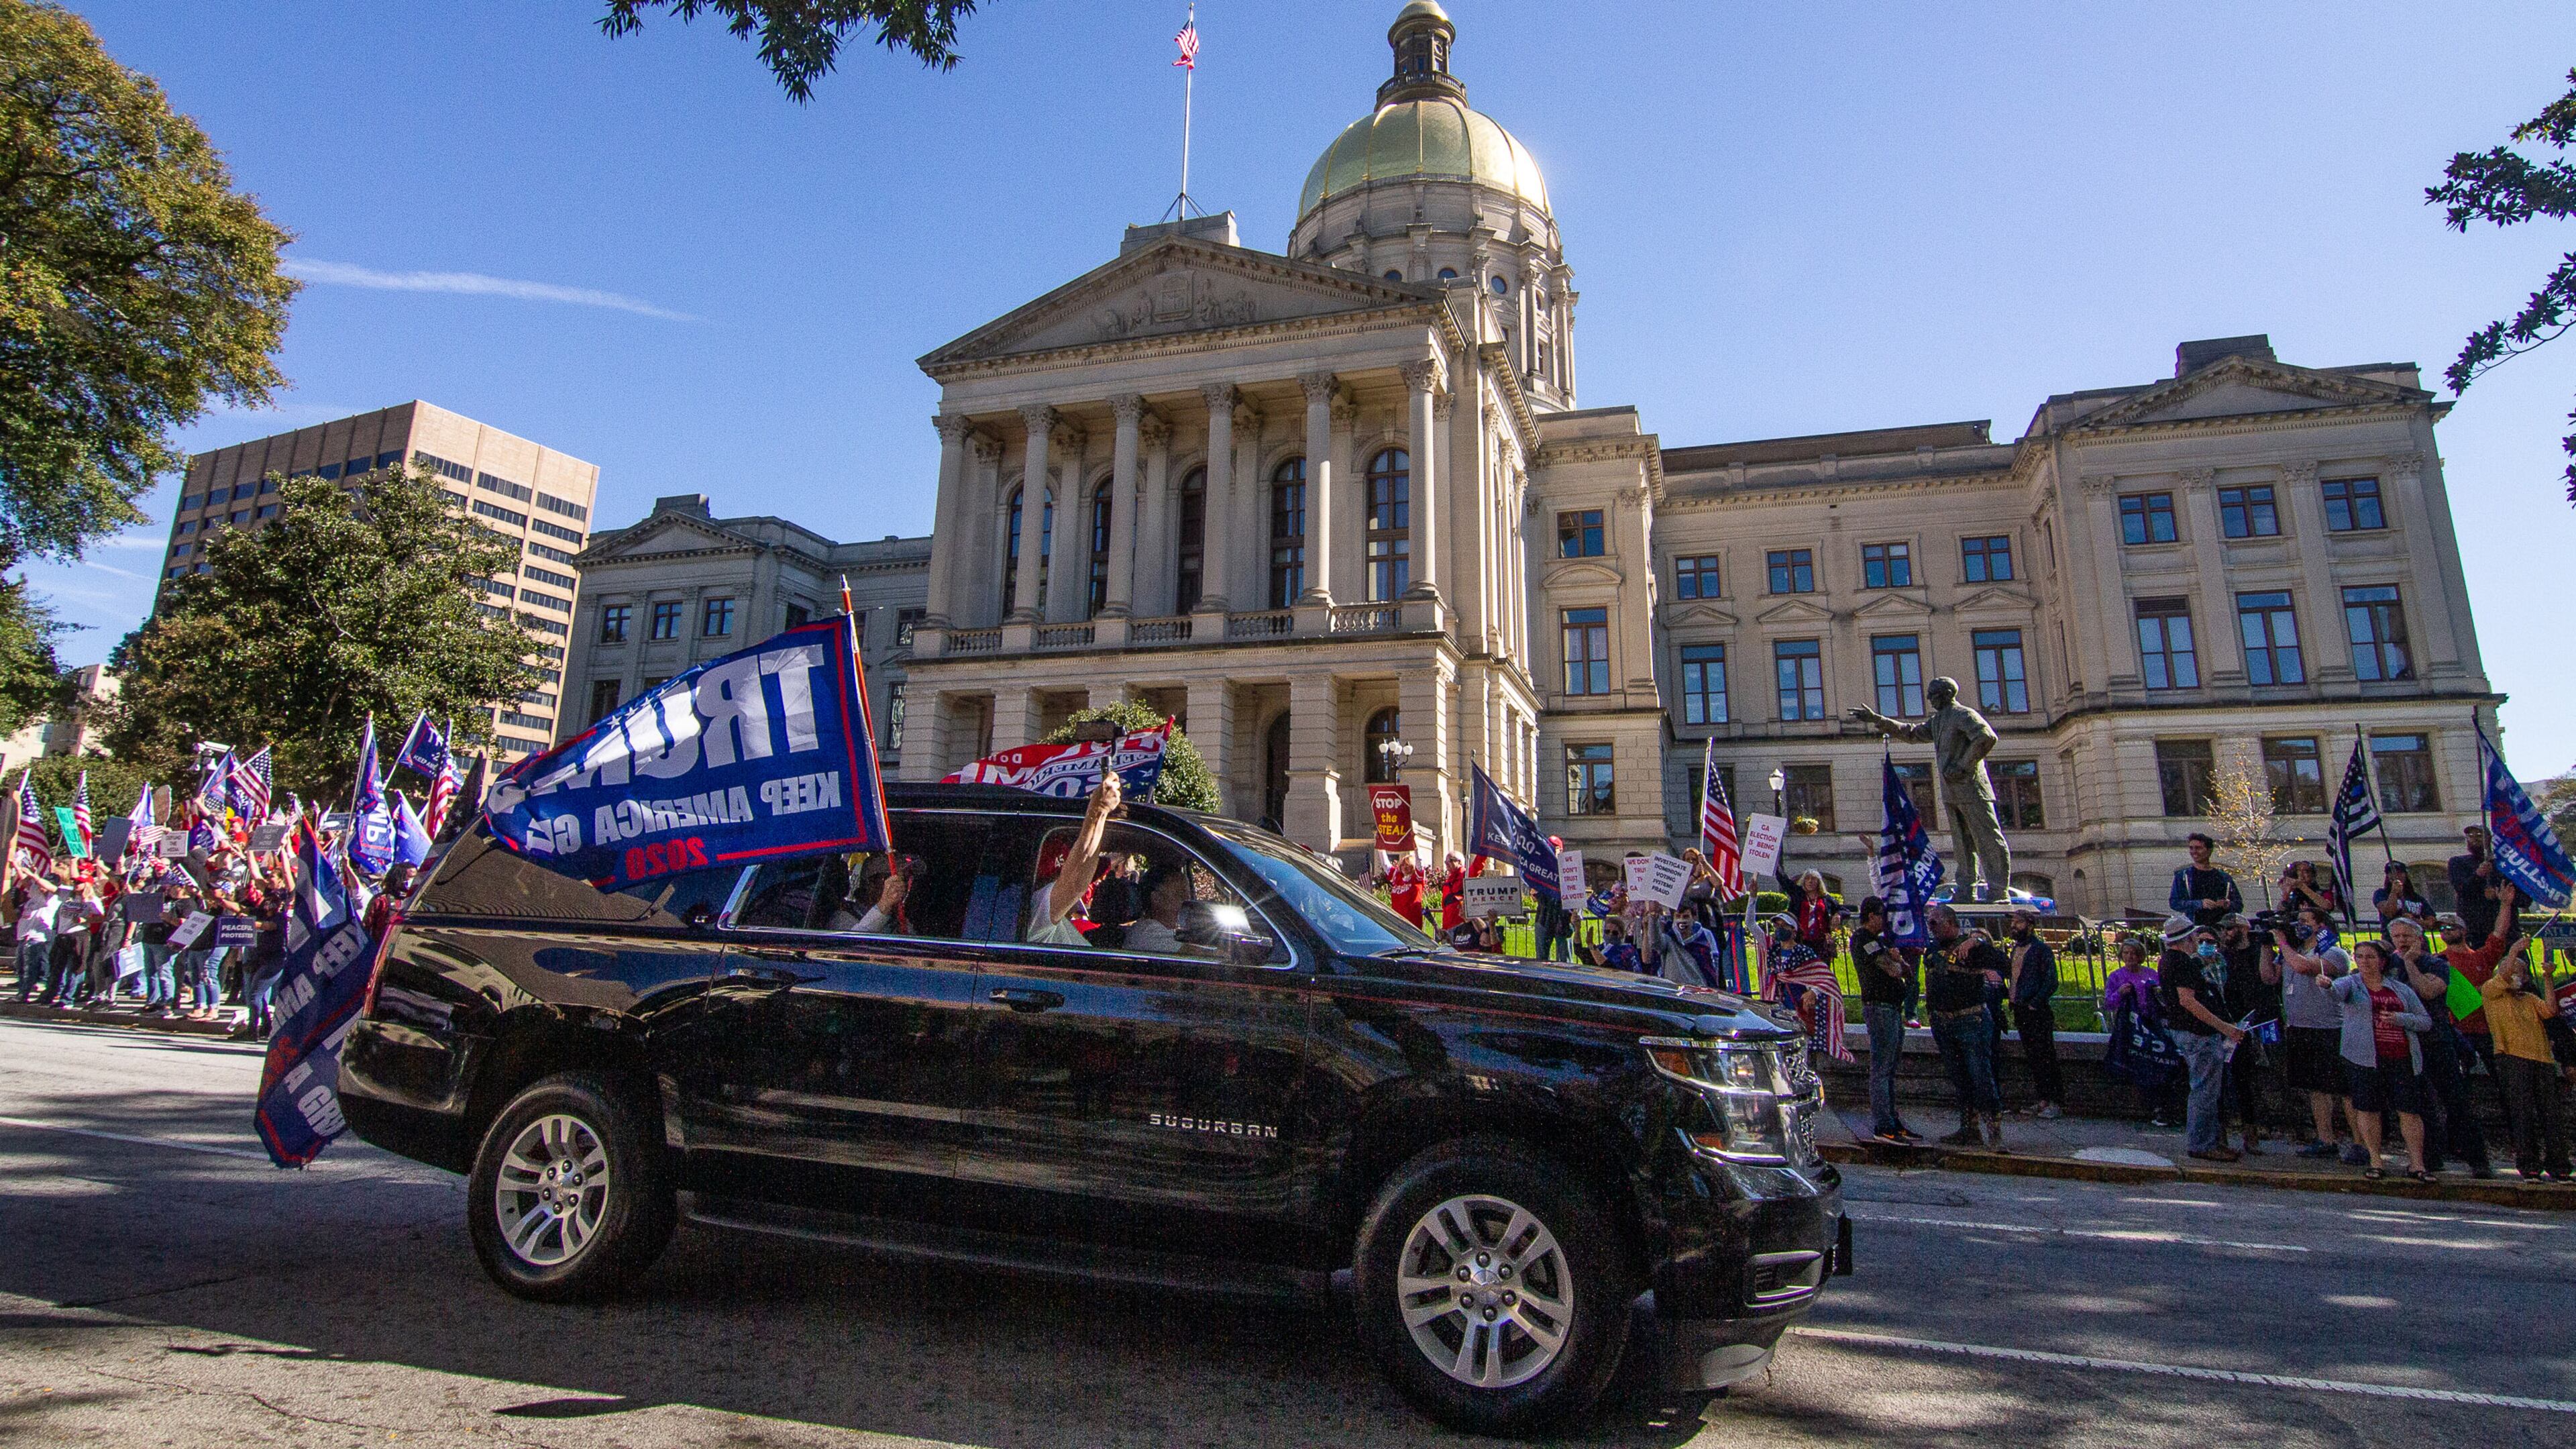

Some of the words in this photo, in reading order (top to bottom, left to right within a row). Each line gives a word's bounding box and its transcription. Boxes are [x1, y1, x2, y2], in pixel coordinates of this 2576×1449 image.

[1375, 798, 1402, 809] STOP
[1381, 812, 1397, 823] the
[1378, 824, 1405, 836] STEAL
[1761, 824, 1770, 832] GA
[1750, 831, 1778, 843] ELECTION
[1757, 841, 1774, 851] BEING
[1749, 849, 1770, 859] STOLEN
[1654, 856, 1687, 871] INVESTIGATE
[1529, 863, 1560, 883] GREAT
[1654, 863, 1682, 877] DOMINION
[1656, 871, 1676, 883] VOTING
[1652, 878, 1674, 890] SYSTEMS
[1468, 887, 1518, 896] TRUMP
[1652, 885, 1670, 896] FRAUD
[1591, 897, 1609, 912] TRUMP
[1149, 1114, 1278, 1138] SUBURBAN
